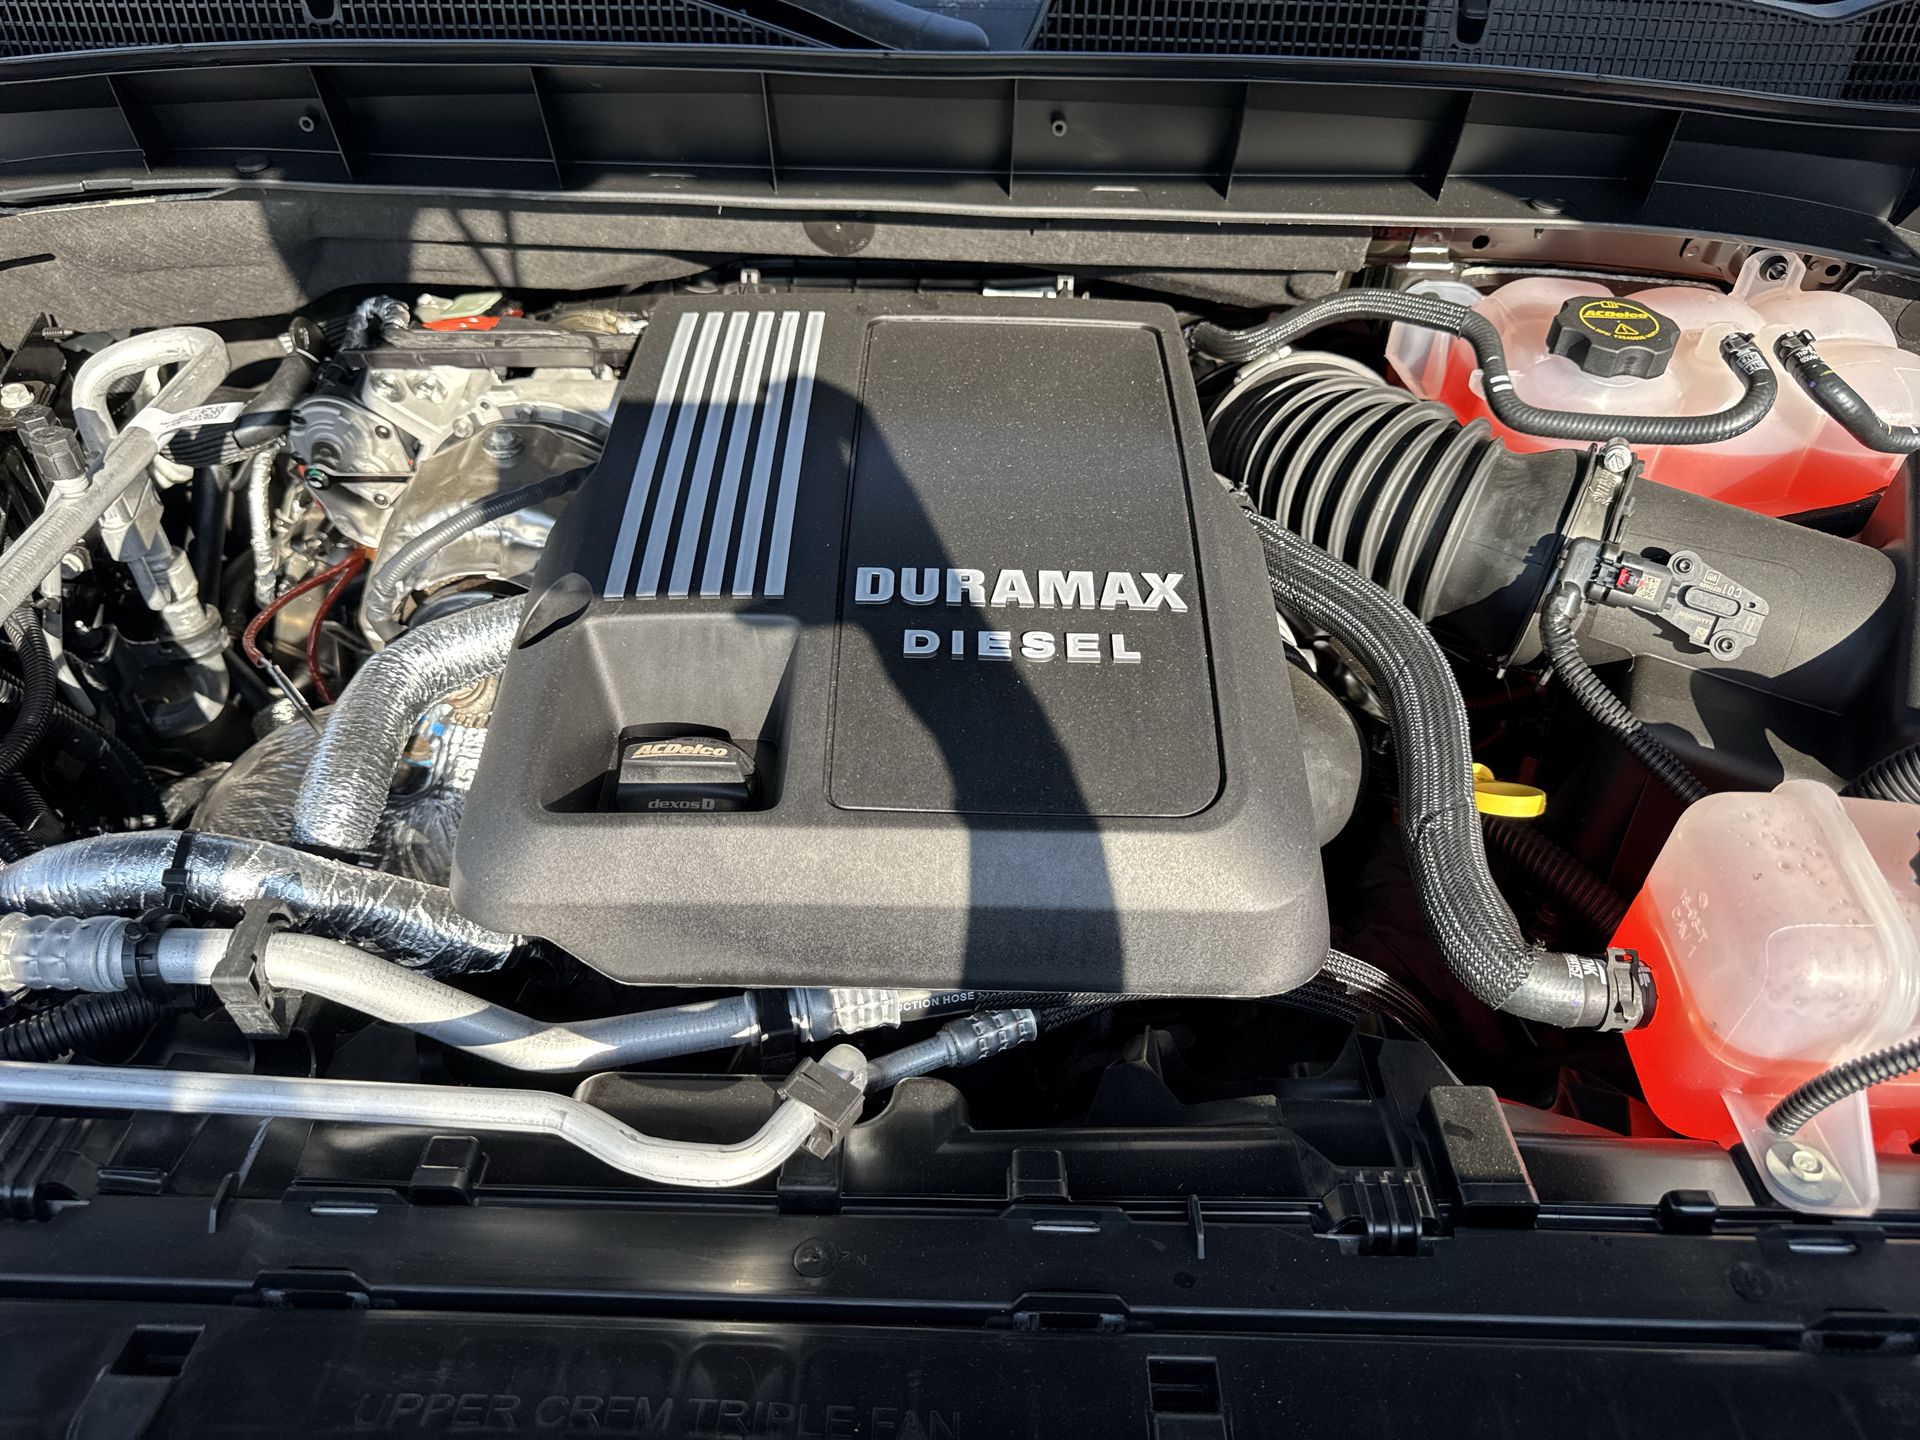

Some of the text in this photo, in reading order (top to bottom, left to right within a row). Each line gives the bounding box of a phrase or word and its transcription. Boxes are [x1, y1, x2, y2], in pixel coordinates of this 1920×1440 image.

[1584, 309, 1648, 319] ACDelco
[855, 567, 1188, 612] DURAMAX
[903, 629, 1142, 663] DIESEL
[632, 743, 728, 757] ACDelco
[943, 992, 974, 1004] HOSE
[353, 1392, 522, 1429] UPPER
[688, 1398, 856, 1439] TRIPLE
[871, 1406, 961, 1440] FAN
